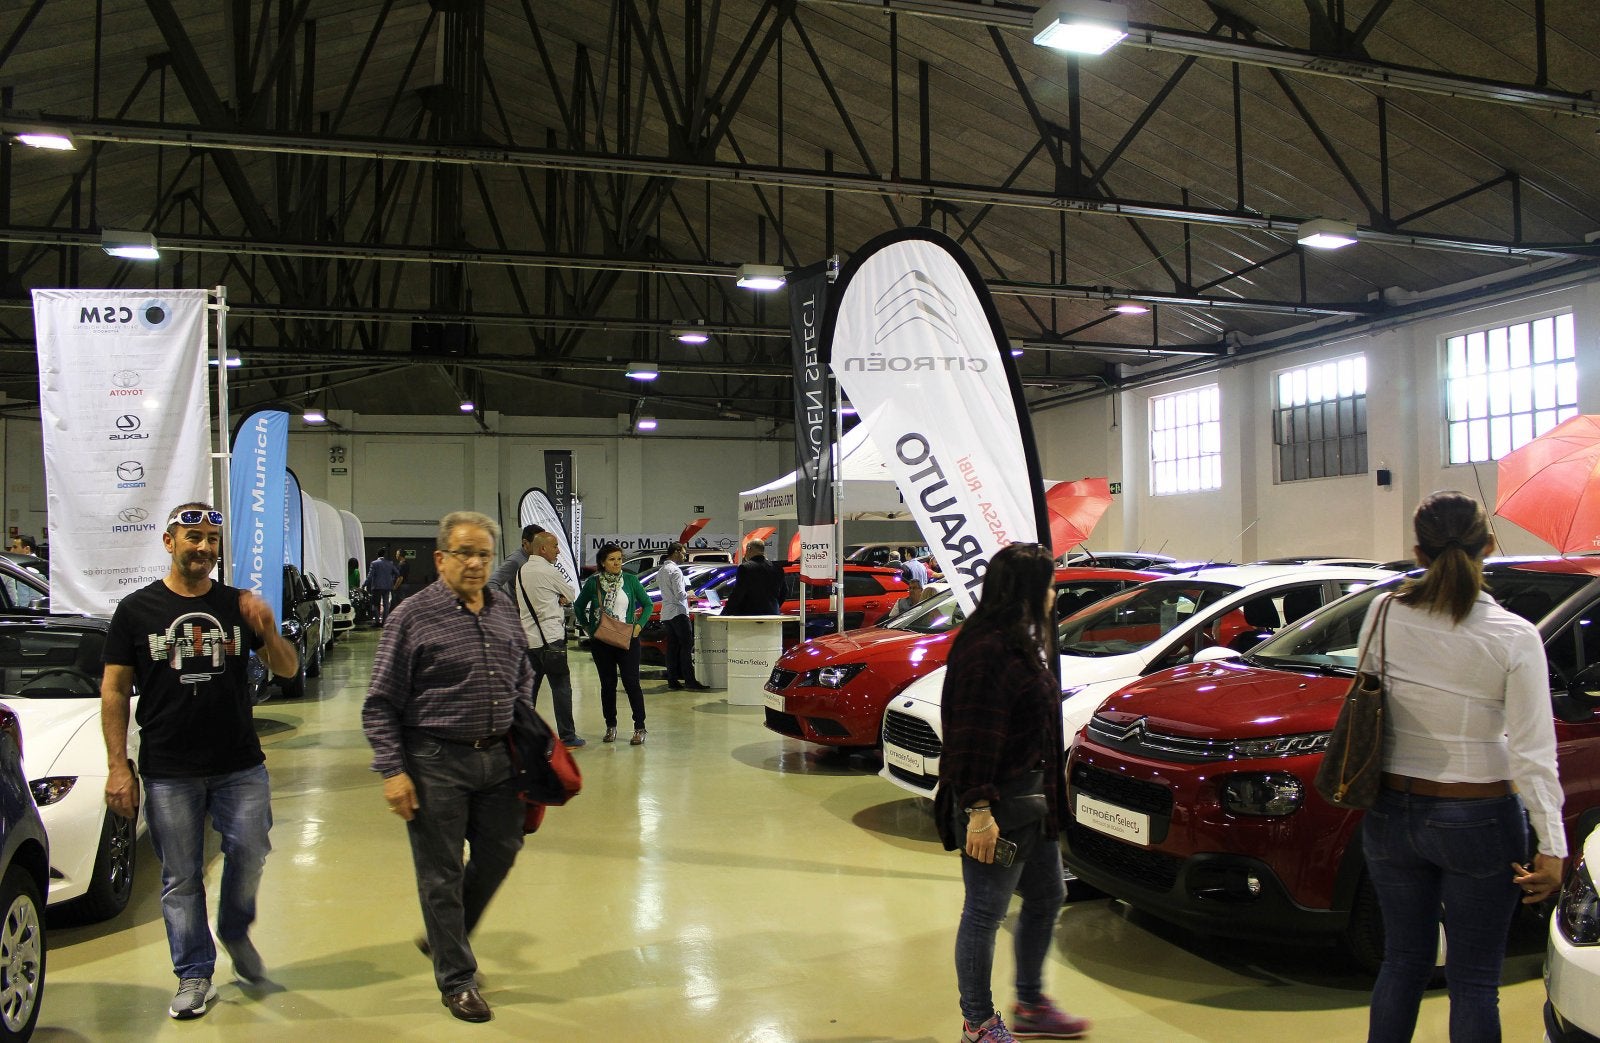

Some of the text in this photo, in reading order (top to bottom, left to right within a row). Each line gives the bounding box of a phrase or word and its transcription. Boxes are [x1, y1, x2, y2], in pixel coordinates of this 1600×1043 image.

[250, 418, 268, 596] Motor Munich
[638, 538, 690, 550] Muni
[1116, 815, 1139, 833] select
